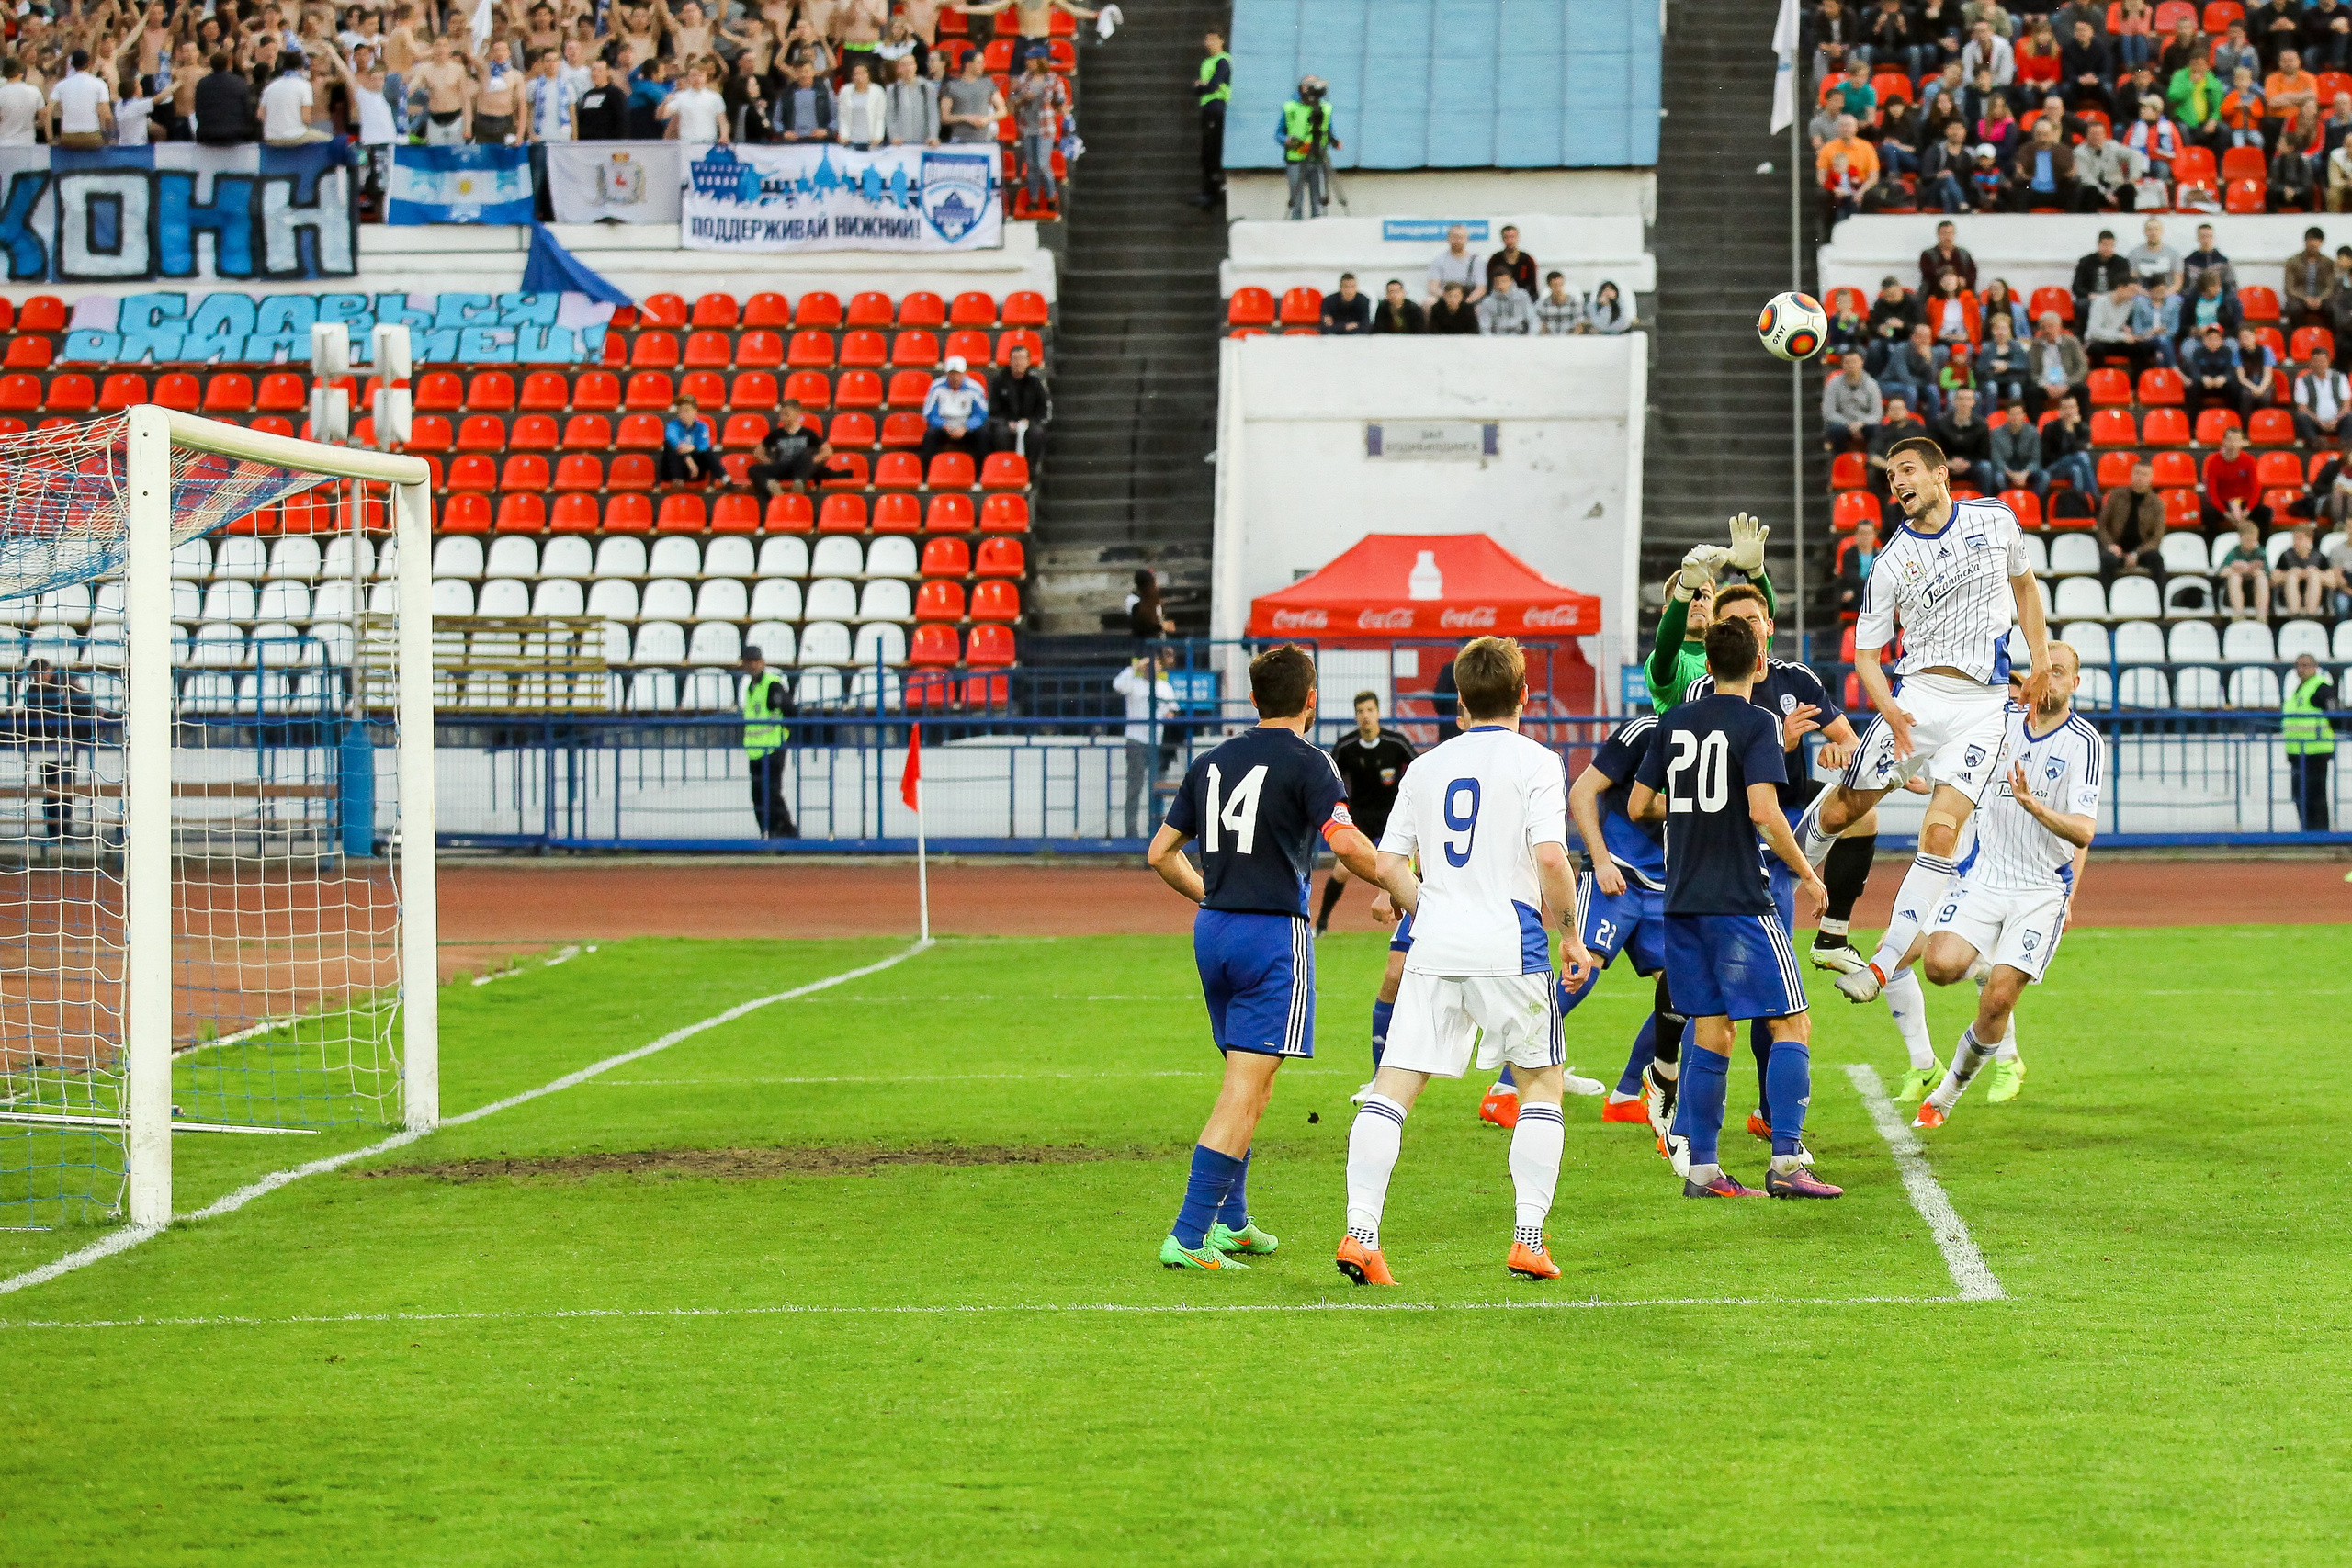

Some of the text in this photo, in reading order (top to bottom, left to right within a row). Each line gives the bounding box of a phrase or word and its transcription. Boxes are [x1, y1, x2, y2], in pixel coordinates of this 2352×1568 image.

[691, 212, 829, 243] ПОДДЕРЖИВАЙ
[1772, 324, 1786, 344] JAKO
[1272, 609, 1328, 629] Coca-Cola
[1357, 607, 1415, 629] Coca-Cola
[1440, 606, 1498, 628] Coca-Cola
[1522, 604, 1579, 627] Coca-Cola
[1666, 729, 1729, 813] 20
[1205, 763, 1269, 854] 14
[1443, 777, 1481, 868] 9
